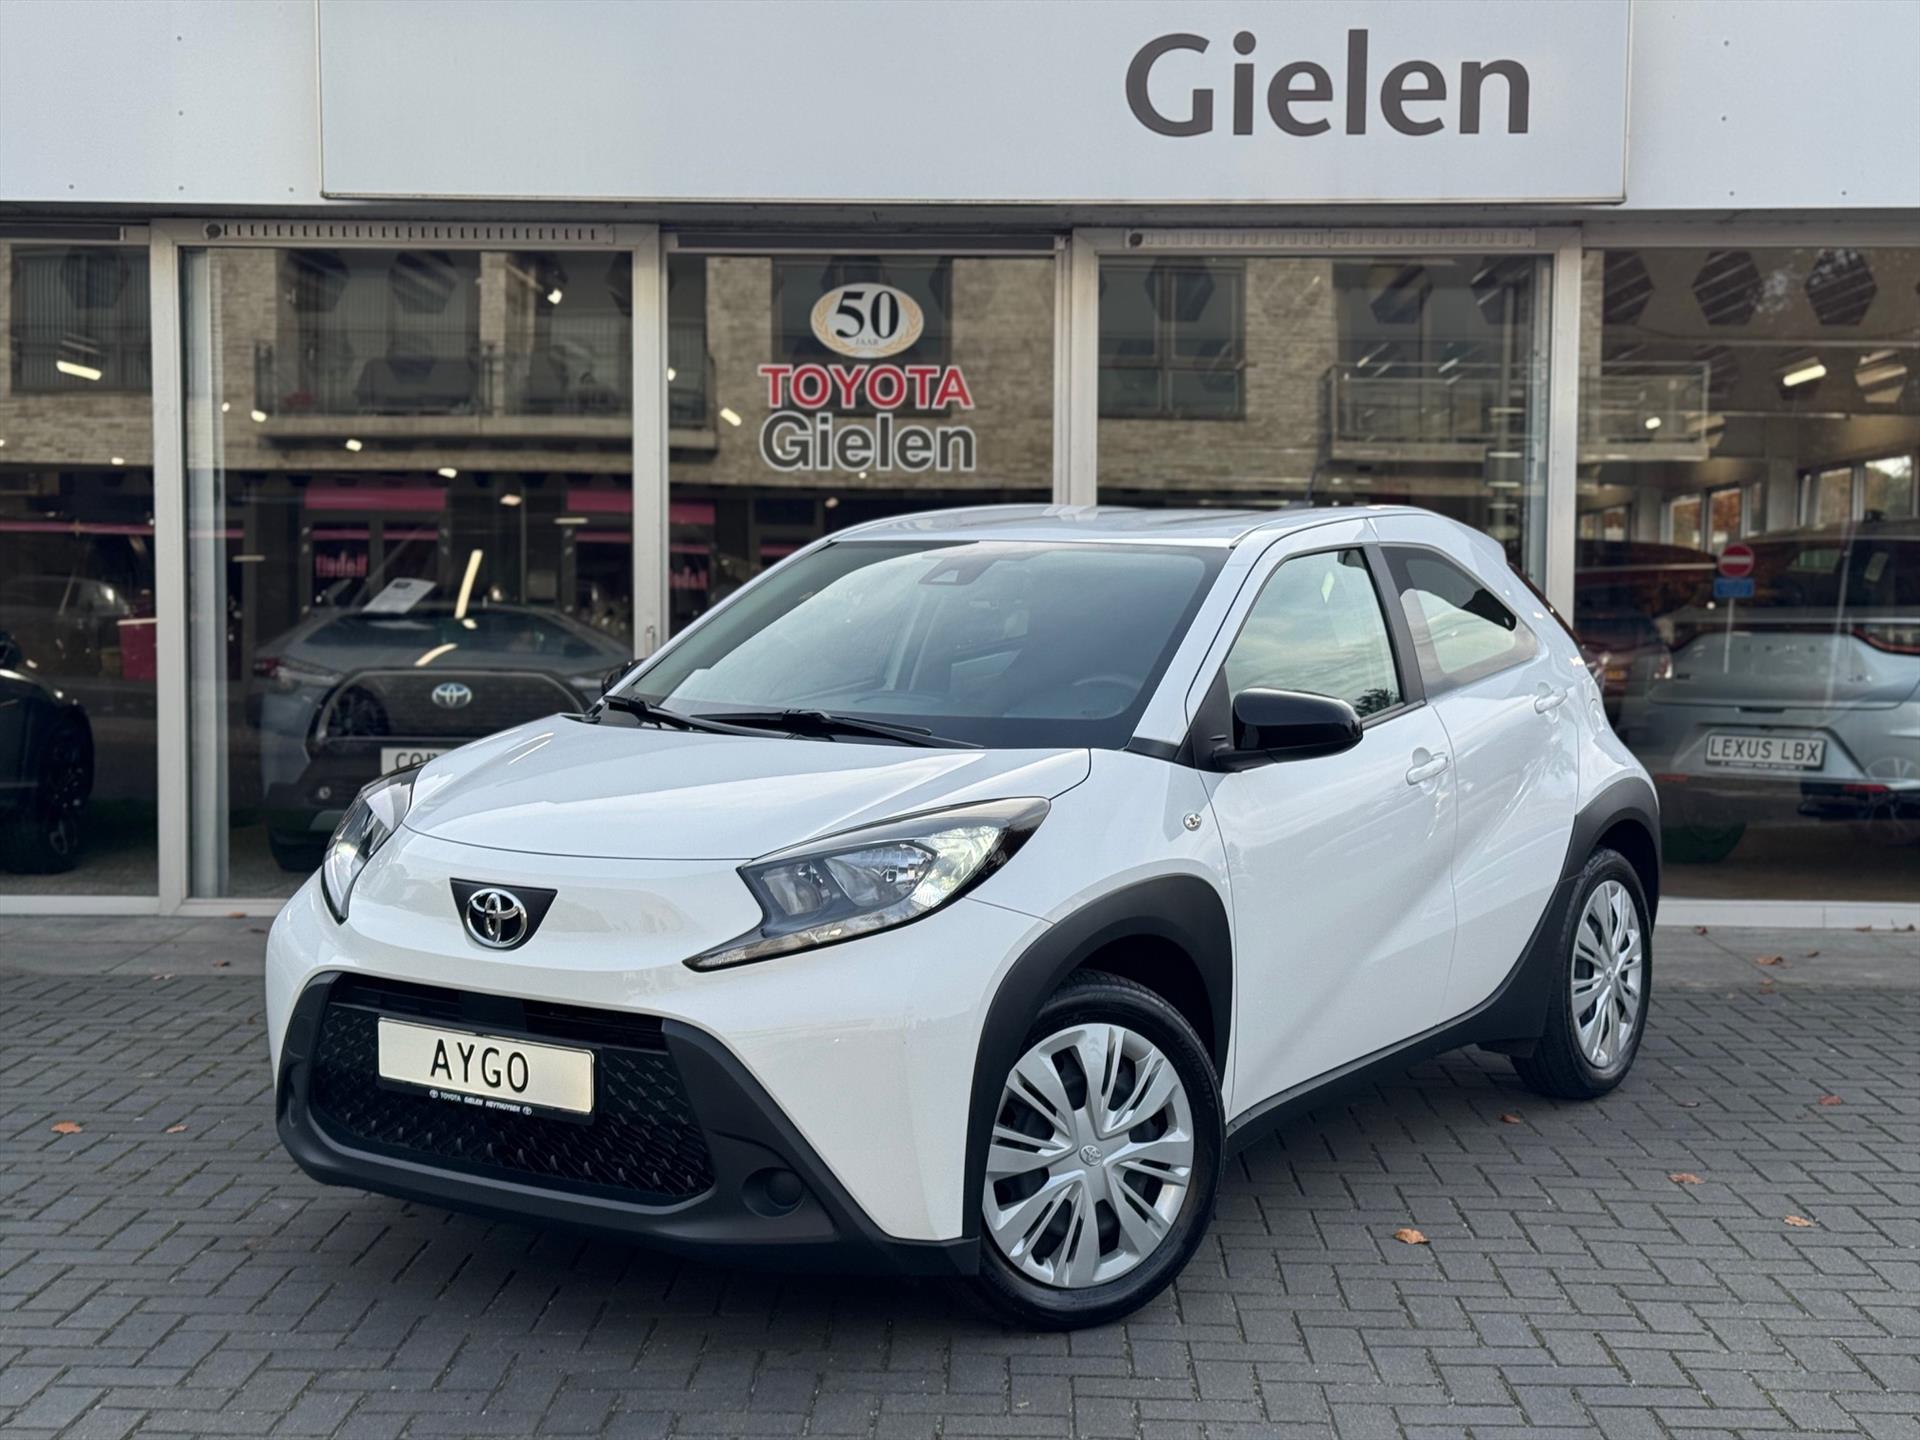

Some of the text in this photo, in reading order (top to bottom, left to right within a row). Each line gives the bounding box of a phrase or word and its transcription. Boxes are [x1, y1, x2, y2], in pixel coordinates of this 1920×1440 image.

[1125, 28, 1530, 137] Gielen
[835, 290, 899, 339] 50
[758, 363, 975, 410] TOYOTA
[759, 411, 977, 472] Gielen
[1710, 738, 1820, 762] LEXUS LBX
[430, 1039, 529, 1093] AYGO
